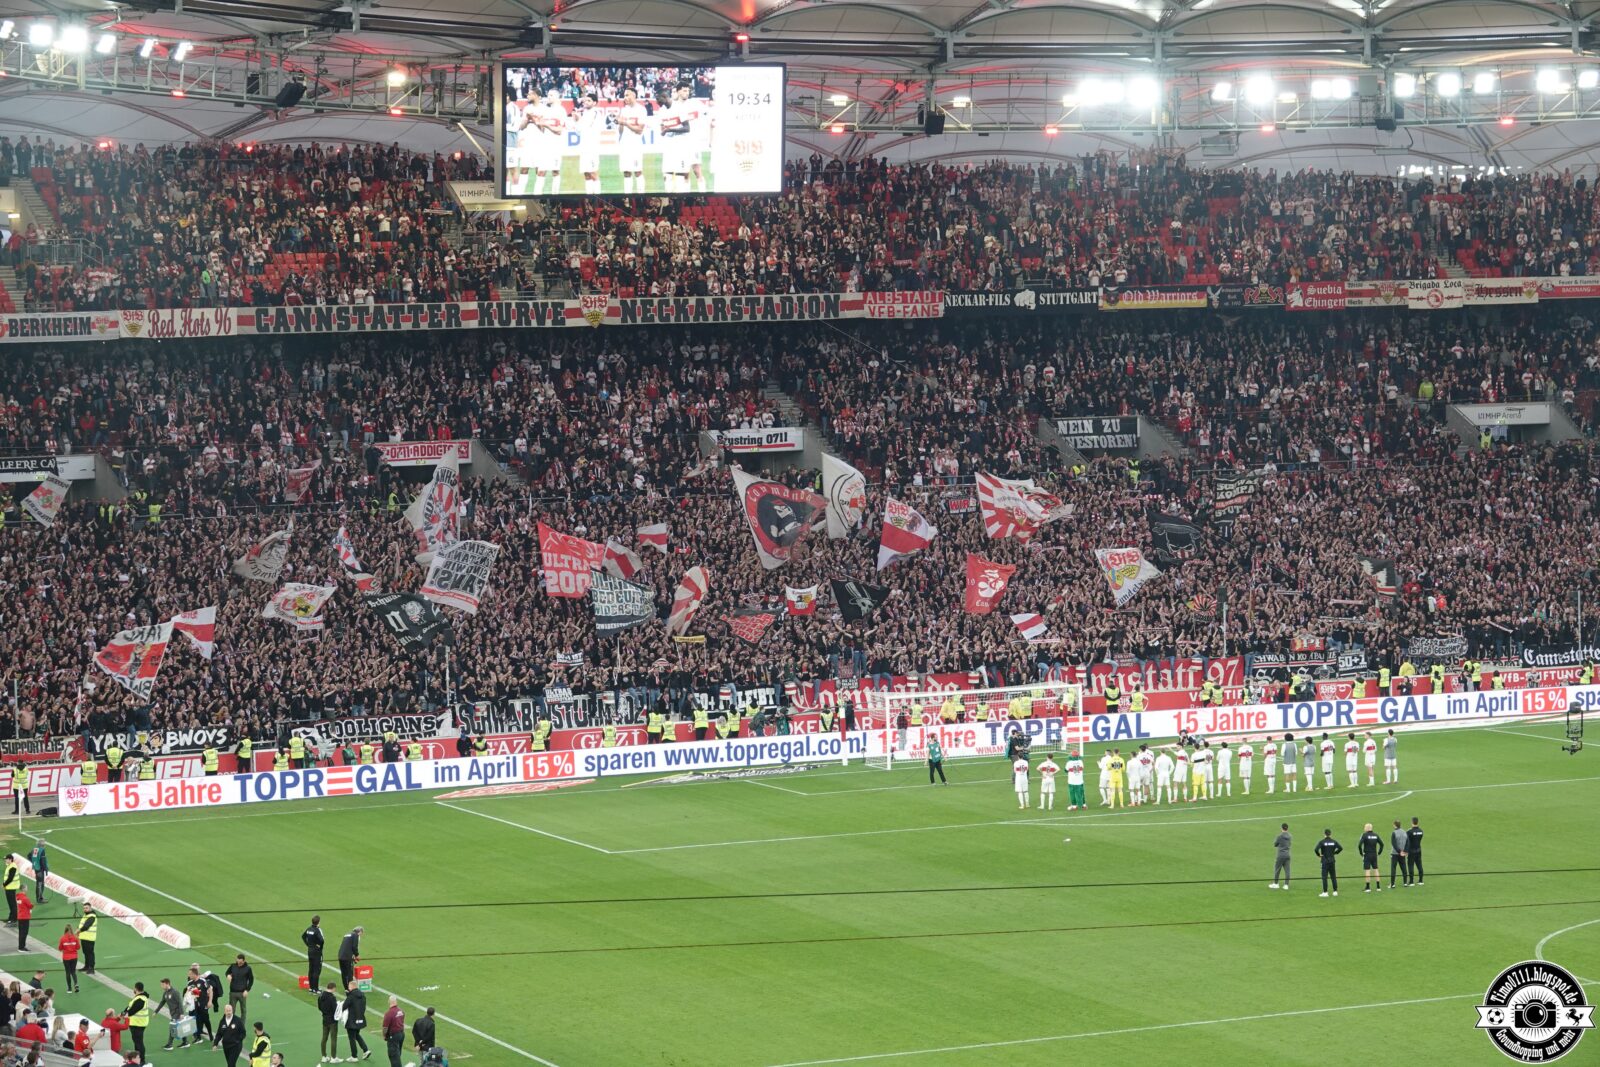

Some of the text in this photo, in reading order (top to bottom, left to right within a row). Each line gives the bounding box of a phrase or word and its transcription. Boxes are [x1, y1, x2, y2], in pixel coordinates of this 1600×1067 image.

[728, 93, 771, 107] 19:34
[1306, 285, 1342, 297] Suebia
[1408, 279, 1463, 293] Brigada Loca
[944, 291, 1098, 309] NECKAR-FILS STUTTGART
[1304, 296, 1345, 310] Ehingen
[255, 293, 841, 334] CANNSTATTER KURVE NECKARSTADION
[866, 304, 941, 318] VFB-FANS
[8, 316, 92, 338] BERKHEIM
[147, 307, 233, 338] Red Hots 96
[1057, 418, 1121, 435] NEIN ZU
[766, 432, 788, 445] 0711
[1206, 659, 1239, 687] 97
[1173, 710, 1199, 734] 15
[1206, 706, 1268, 733] Jahre
[1277, 696, 1437, 730] TOPREGAL
[1447, 694, 1470, 716] im
[1475, 691, 1518, 719] April
[315, 715, 437, 741] HOOLIGANS
[911, 724, 976, 752] Jahre
[109, 783, 140, 811] 15
[149, 779, 222, 809] Jahre
[233, 763, 422, 804] TOPREGAL
[434, 761, 460, 785] im
[467, 756, 517, 786] April
[584, 749, 656, 778] sparen
[66, 787, 89, 800] VfB
